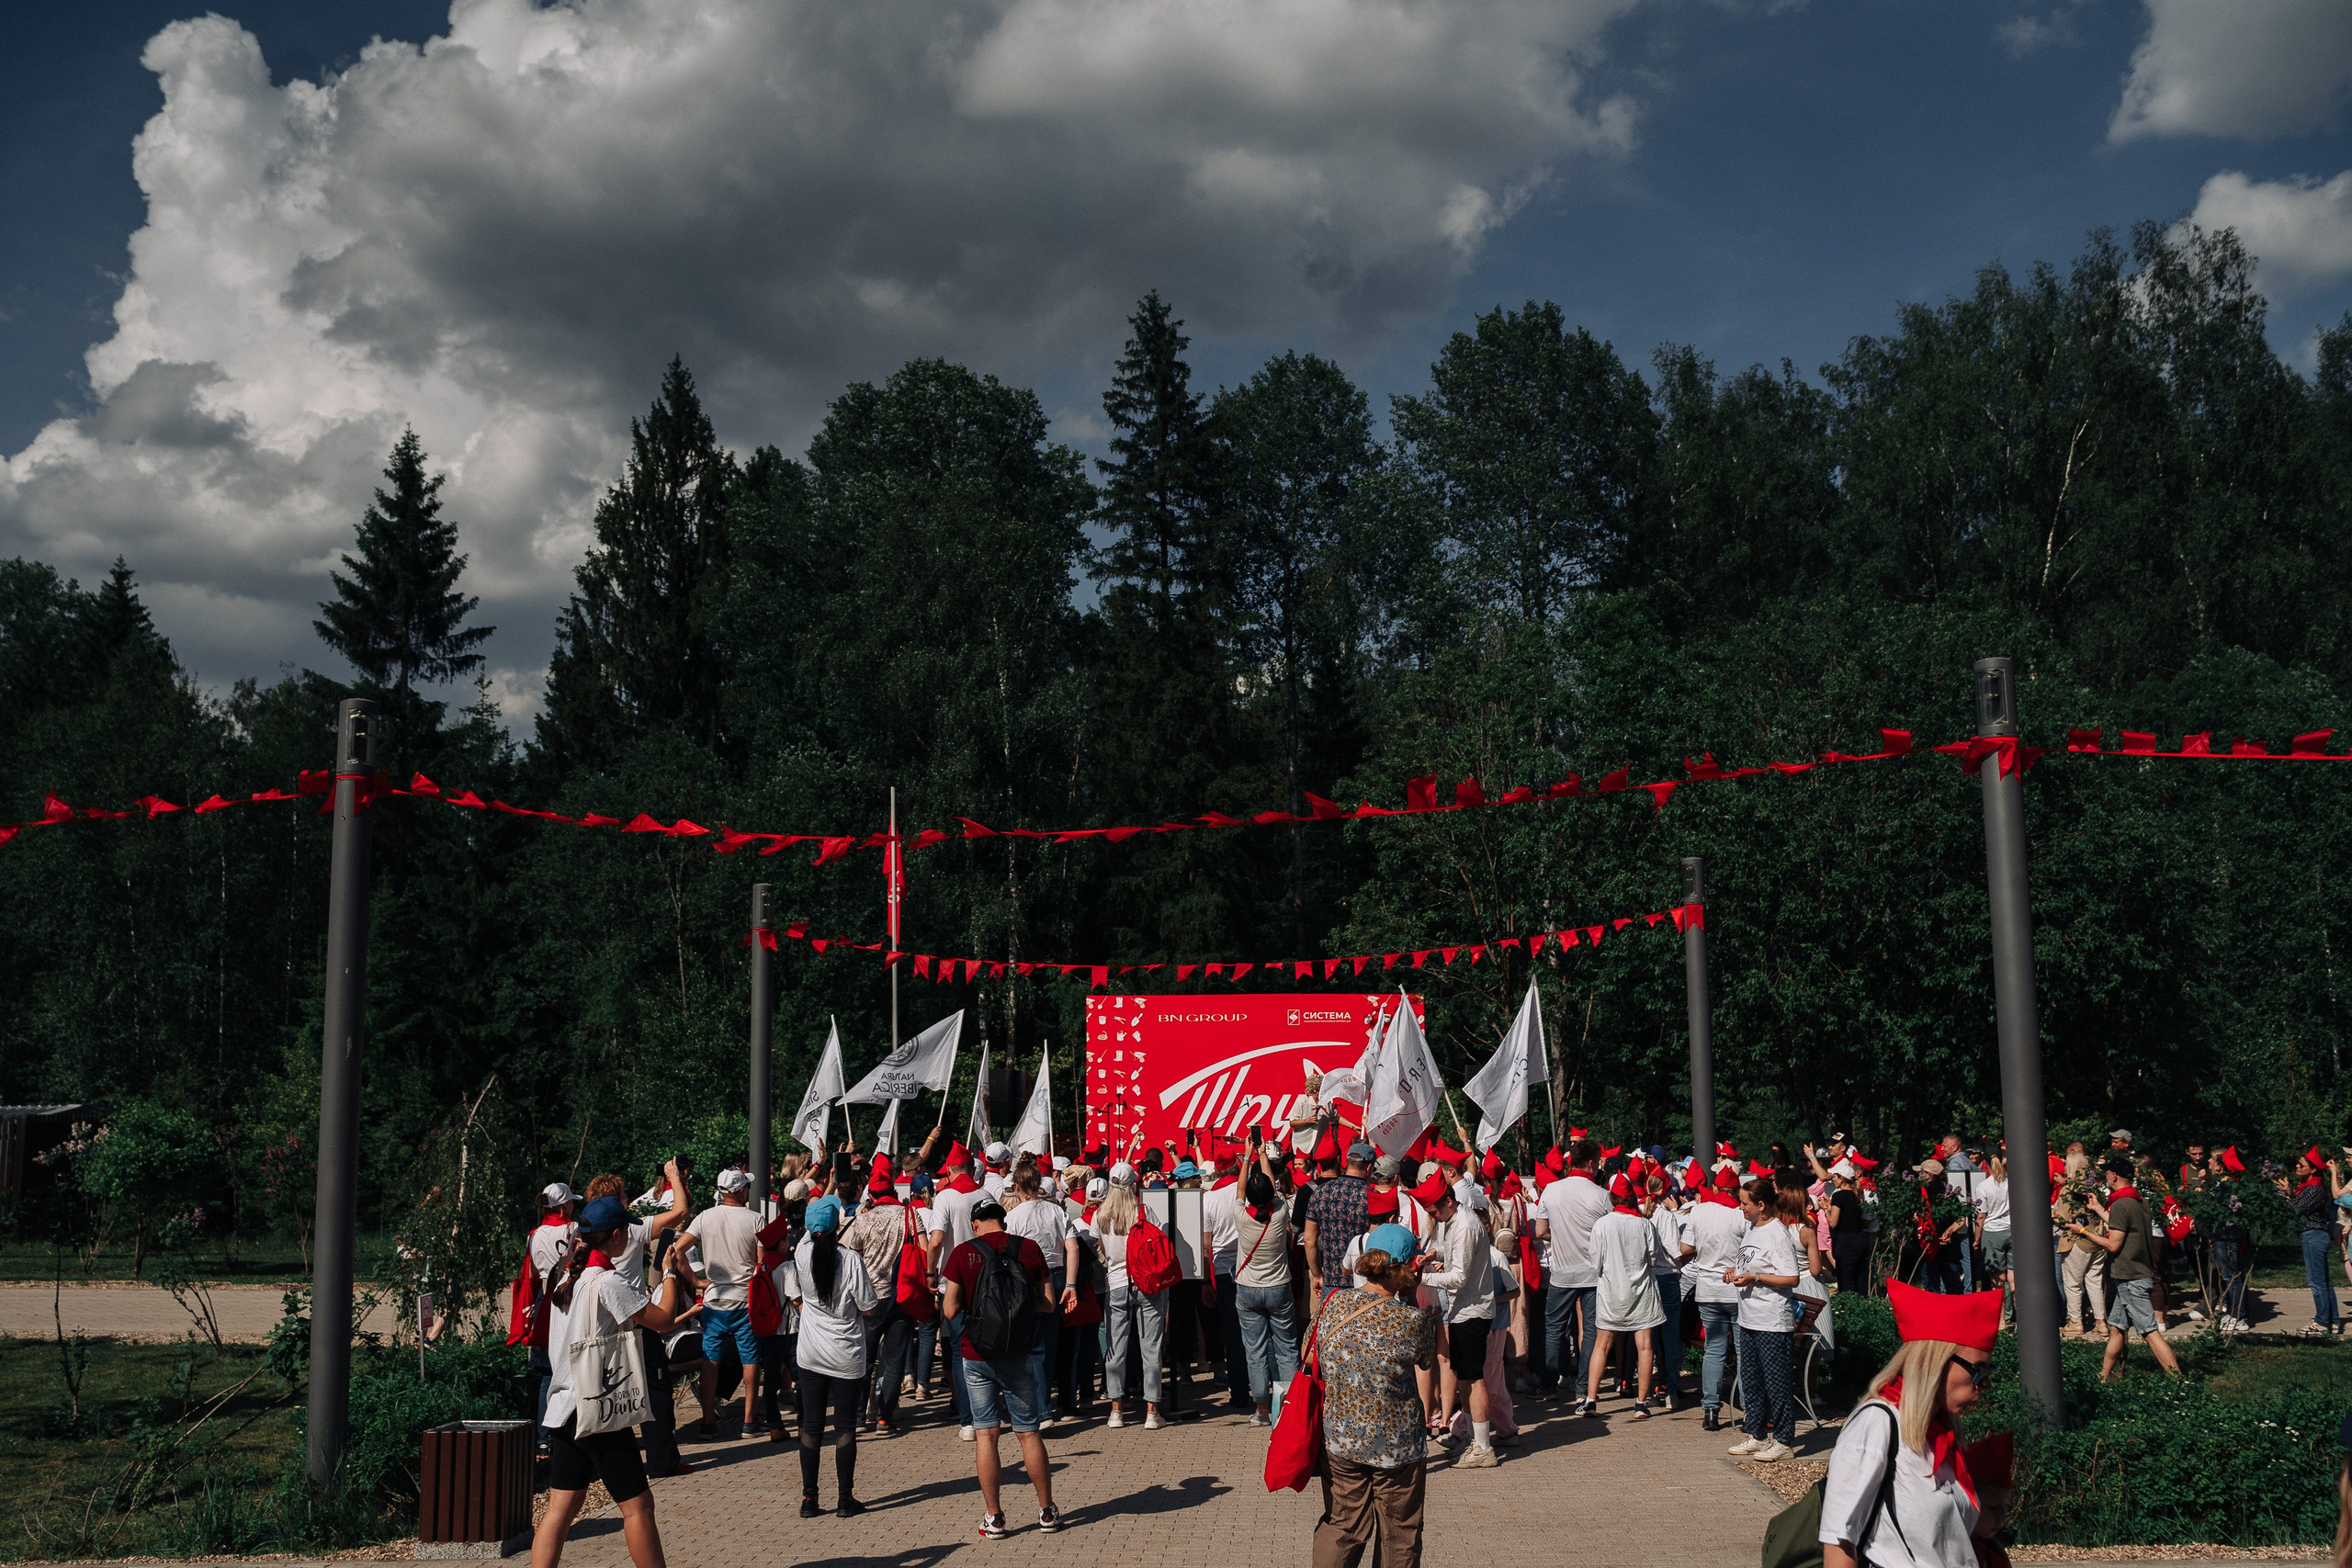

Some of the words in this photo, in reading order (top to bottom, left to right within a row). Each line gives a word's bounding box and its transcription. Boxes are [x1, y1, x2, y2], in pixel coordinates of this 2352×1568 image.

[1158, 1013, 1183, 1022] BN
[1185, 1013, 1248, 1022] GROUP
[1303, 1011, 1351, 1020] СИСТЕМА
[1159, 1041, 1351, 1145] Тру
[614, 1389, 631, 1401] BORN
[631, 1387, 640, 1396] TO
[596, 1396, 648, 1423] Dance
